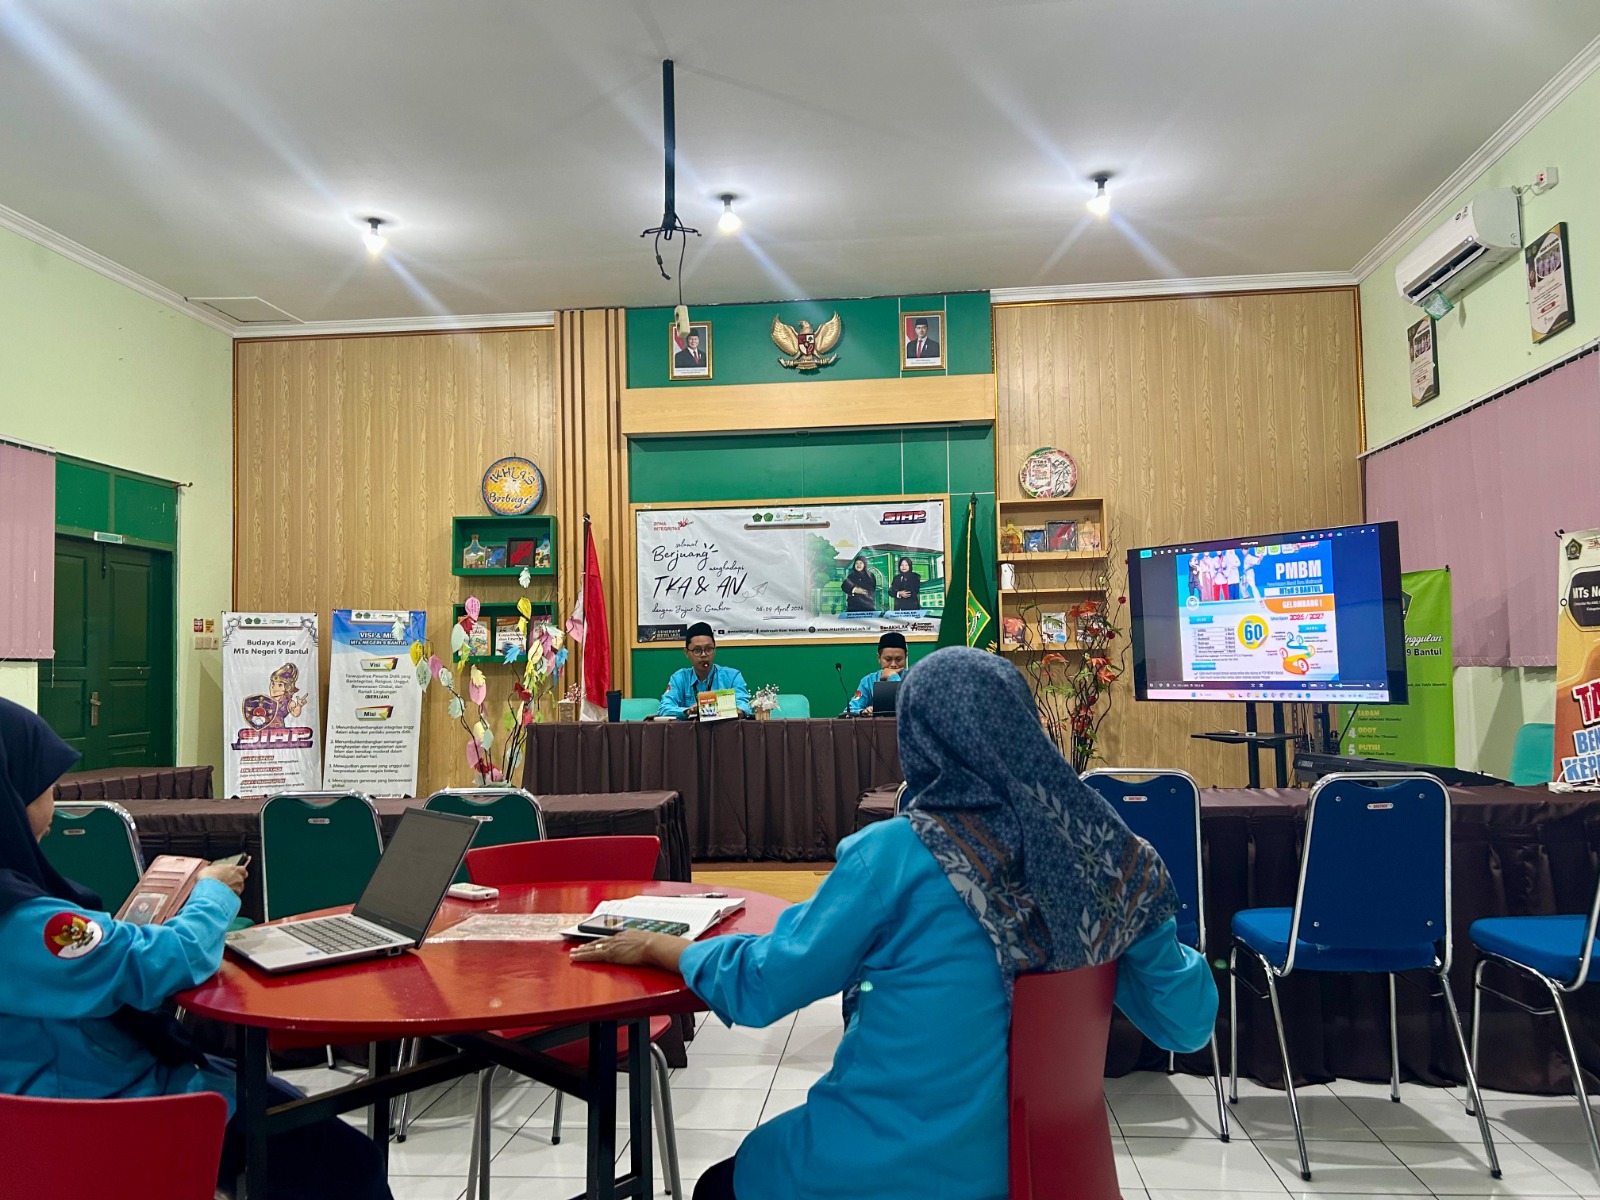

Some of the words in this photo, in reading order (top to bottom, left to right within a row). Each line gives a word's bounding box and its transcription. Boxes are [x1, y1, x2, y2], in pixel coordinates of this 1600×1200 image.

[676, 539, 699, 548] selamat
[652, 546, 709, 572] Berjuang
[709, 560, 744, 577] menghadapi
[1276, 560, 1322, 580] PMBM
[653, 576, 693, 599] TKA
[694, 576, 710, 596] &
[716, 572, 748, 599] AN
[1573, 587, 1590, 599] MTs
[652, 602, 674, 619] dengan
[705, 601, 732, 613] Gembira
[774, 604, 791, 615] April
[1282, 600, 1319, 609] GELOMBANG
[1244, 624, 1263, 641] 60
[251, 648, 277, 656] Negeri
[1414, 648, 1442, 656] Bantul
[1348, 728, 1356, 738] 4
[1348, 744, 1356, 755] 5
